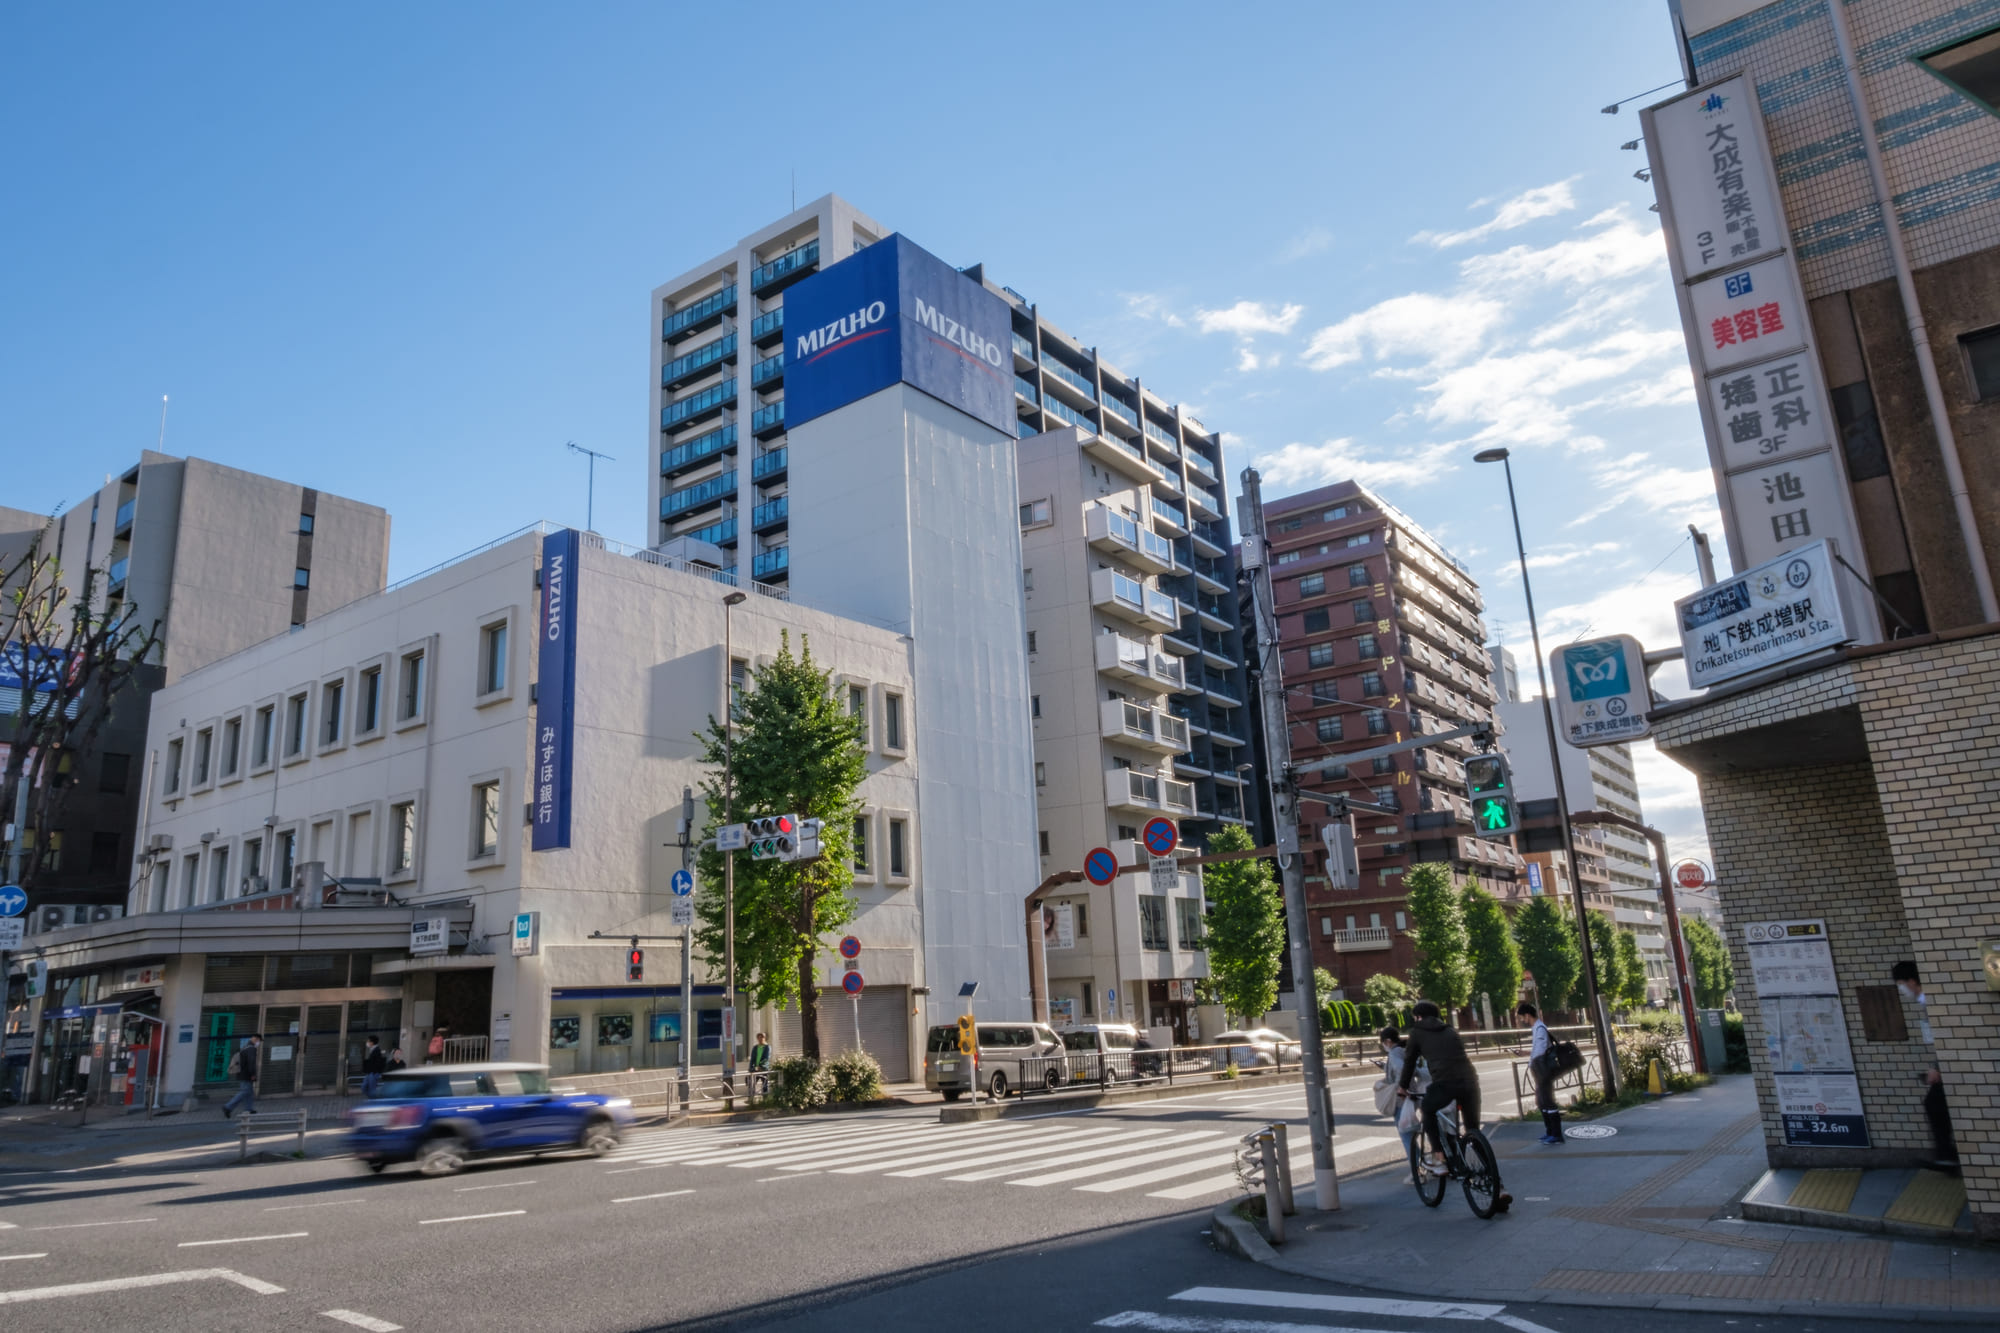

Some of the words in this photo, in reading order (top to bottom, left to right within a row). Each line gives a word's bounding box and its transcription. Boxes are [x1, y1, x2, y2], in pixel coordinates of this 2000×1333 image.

[1705, 123, 1752, 220] 大成有楽
[1696, 231, 1716, 265] 3F
[1727, 273, 1751, 297] 3F
[796, 300, 886, 360] MIZUHO
[915, 296, 1002, 368] MIZUHO
[1711, 302, 1784, 350] 美容室
[1758, 434, 1788, 455] 3F
[1761, 472, 1811, 542] 池田
[548, 554, 563, 641] MIZUHO
[1763, 584, 1775, 595] 02
[1793, 572, 1805, 583] 02
[1695, 628, 1806, 674] Chikatetsu-narimasu
[1810, 617, 1833, 635] Sta.
[1703, 598, 1814, 654] 地下鉄成増駅
[1570, 714, 1643, 735] 地下鉄成増駅
[539, 726, 554, 824] みずほ銀行
[1811, 1121, 1849, 1134] 32.6m
